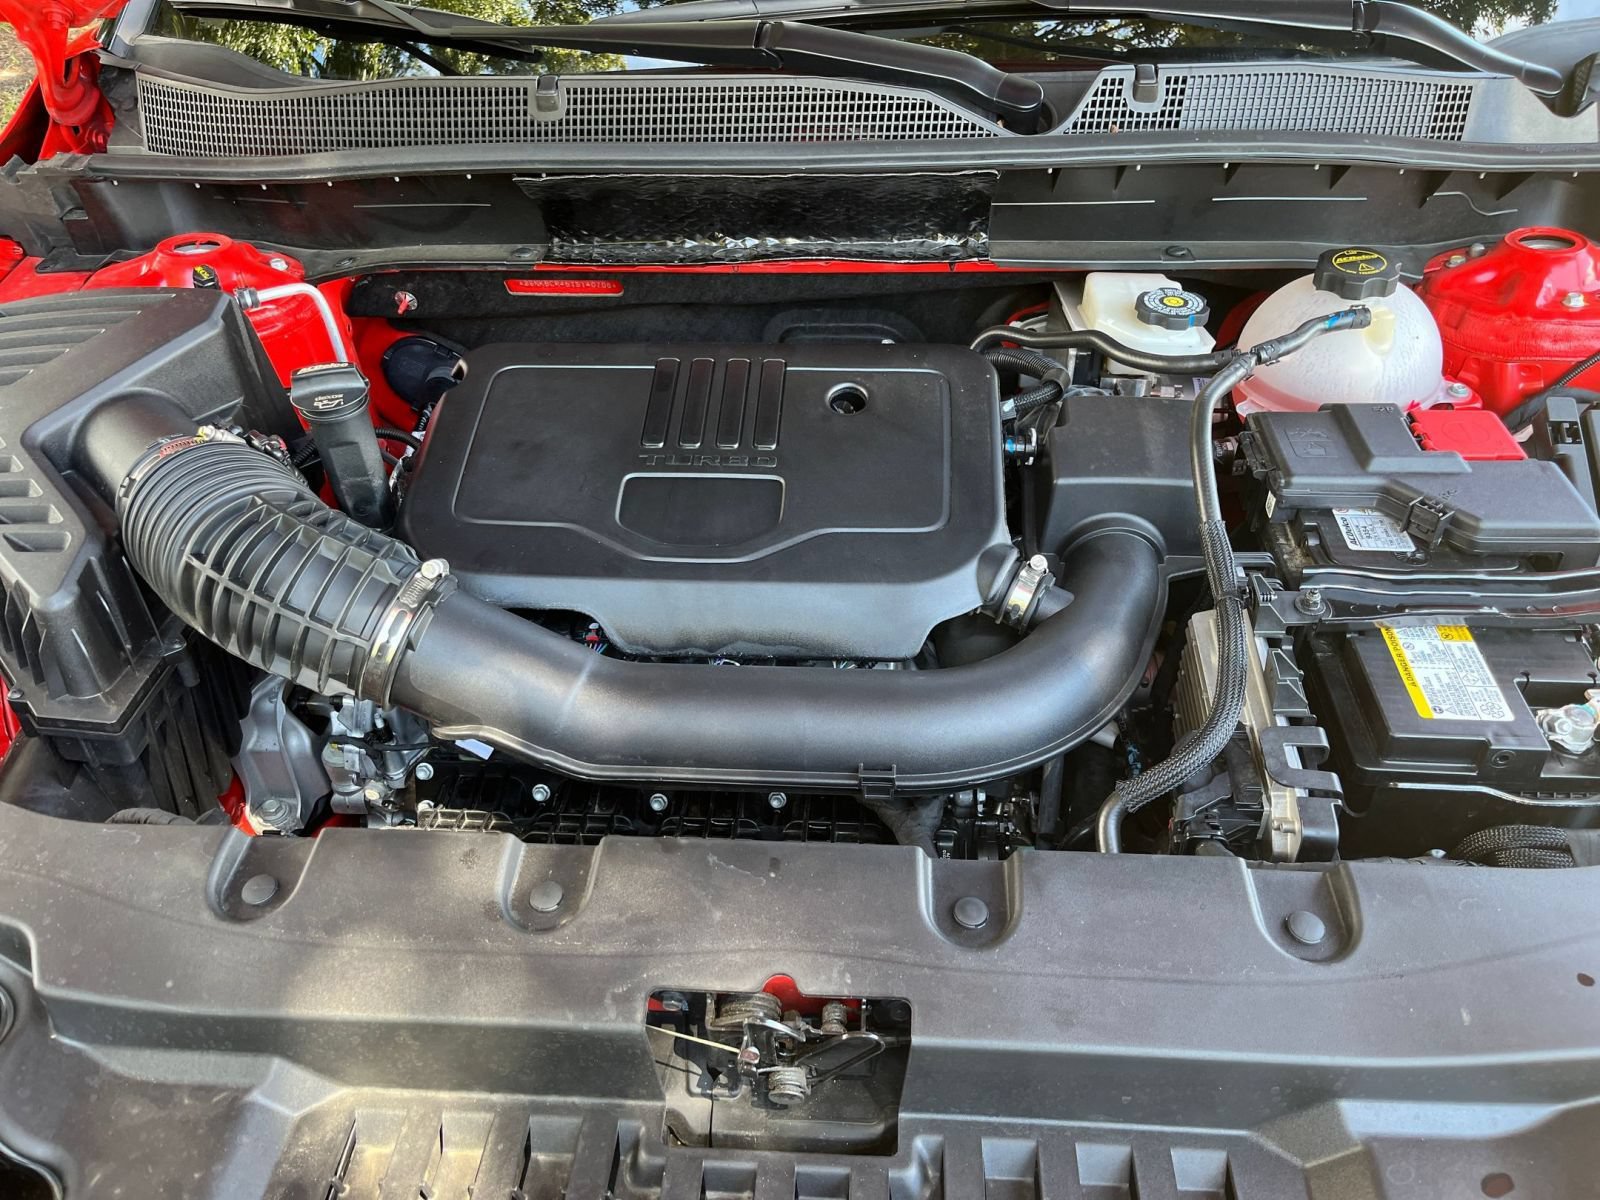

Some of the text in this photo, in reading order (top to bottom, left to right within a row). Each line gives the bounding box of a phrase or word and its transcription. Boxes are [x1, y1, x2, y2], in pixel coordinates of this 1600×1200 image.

[639, 454, 778, 468] TURBO
[1340, 516, 1359, 546] ACDelco
[1396, 653, 1417, 682] DANGER
